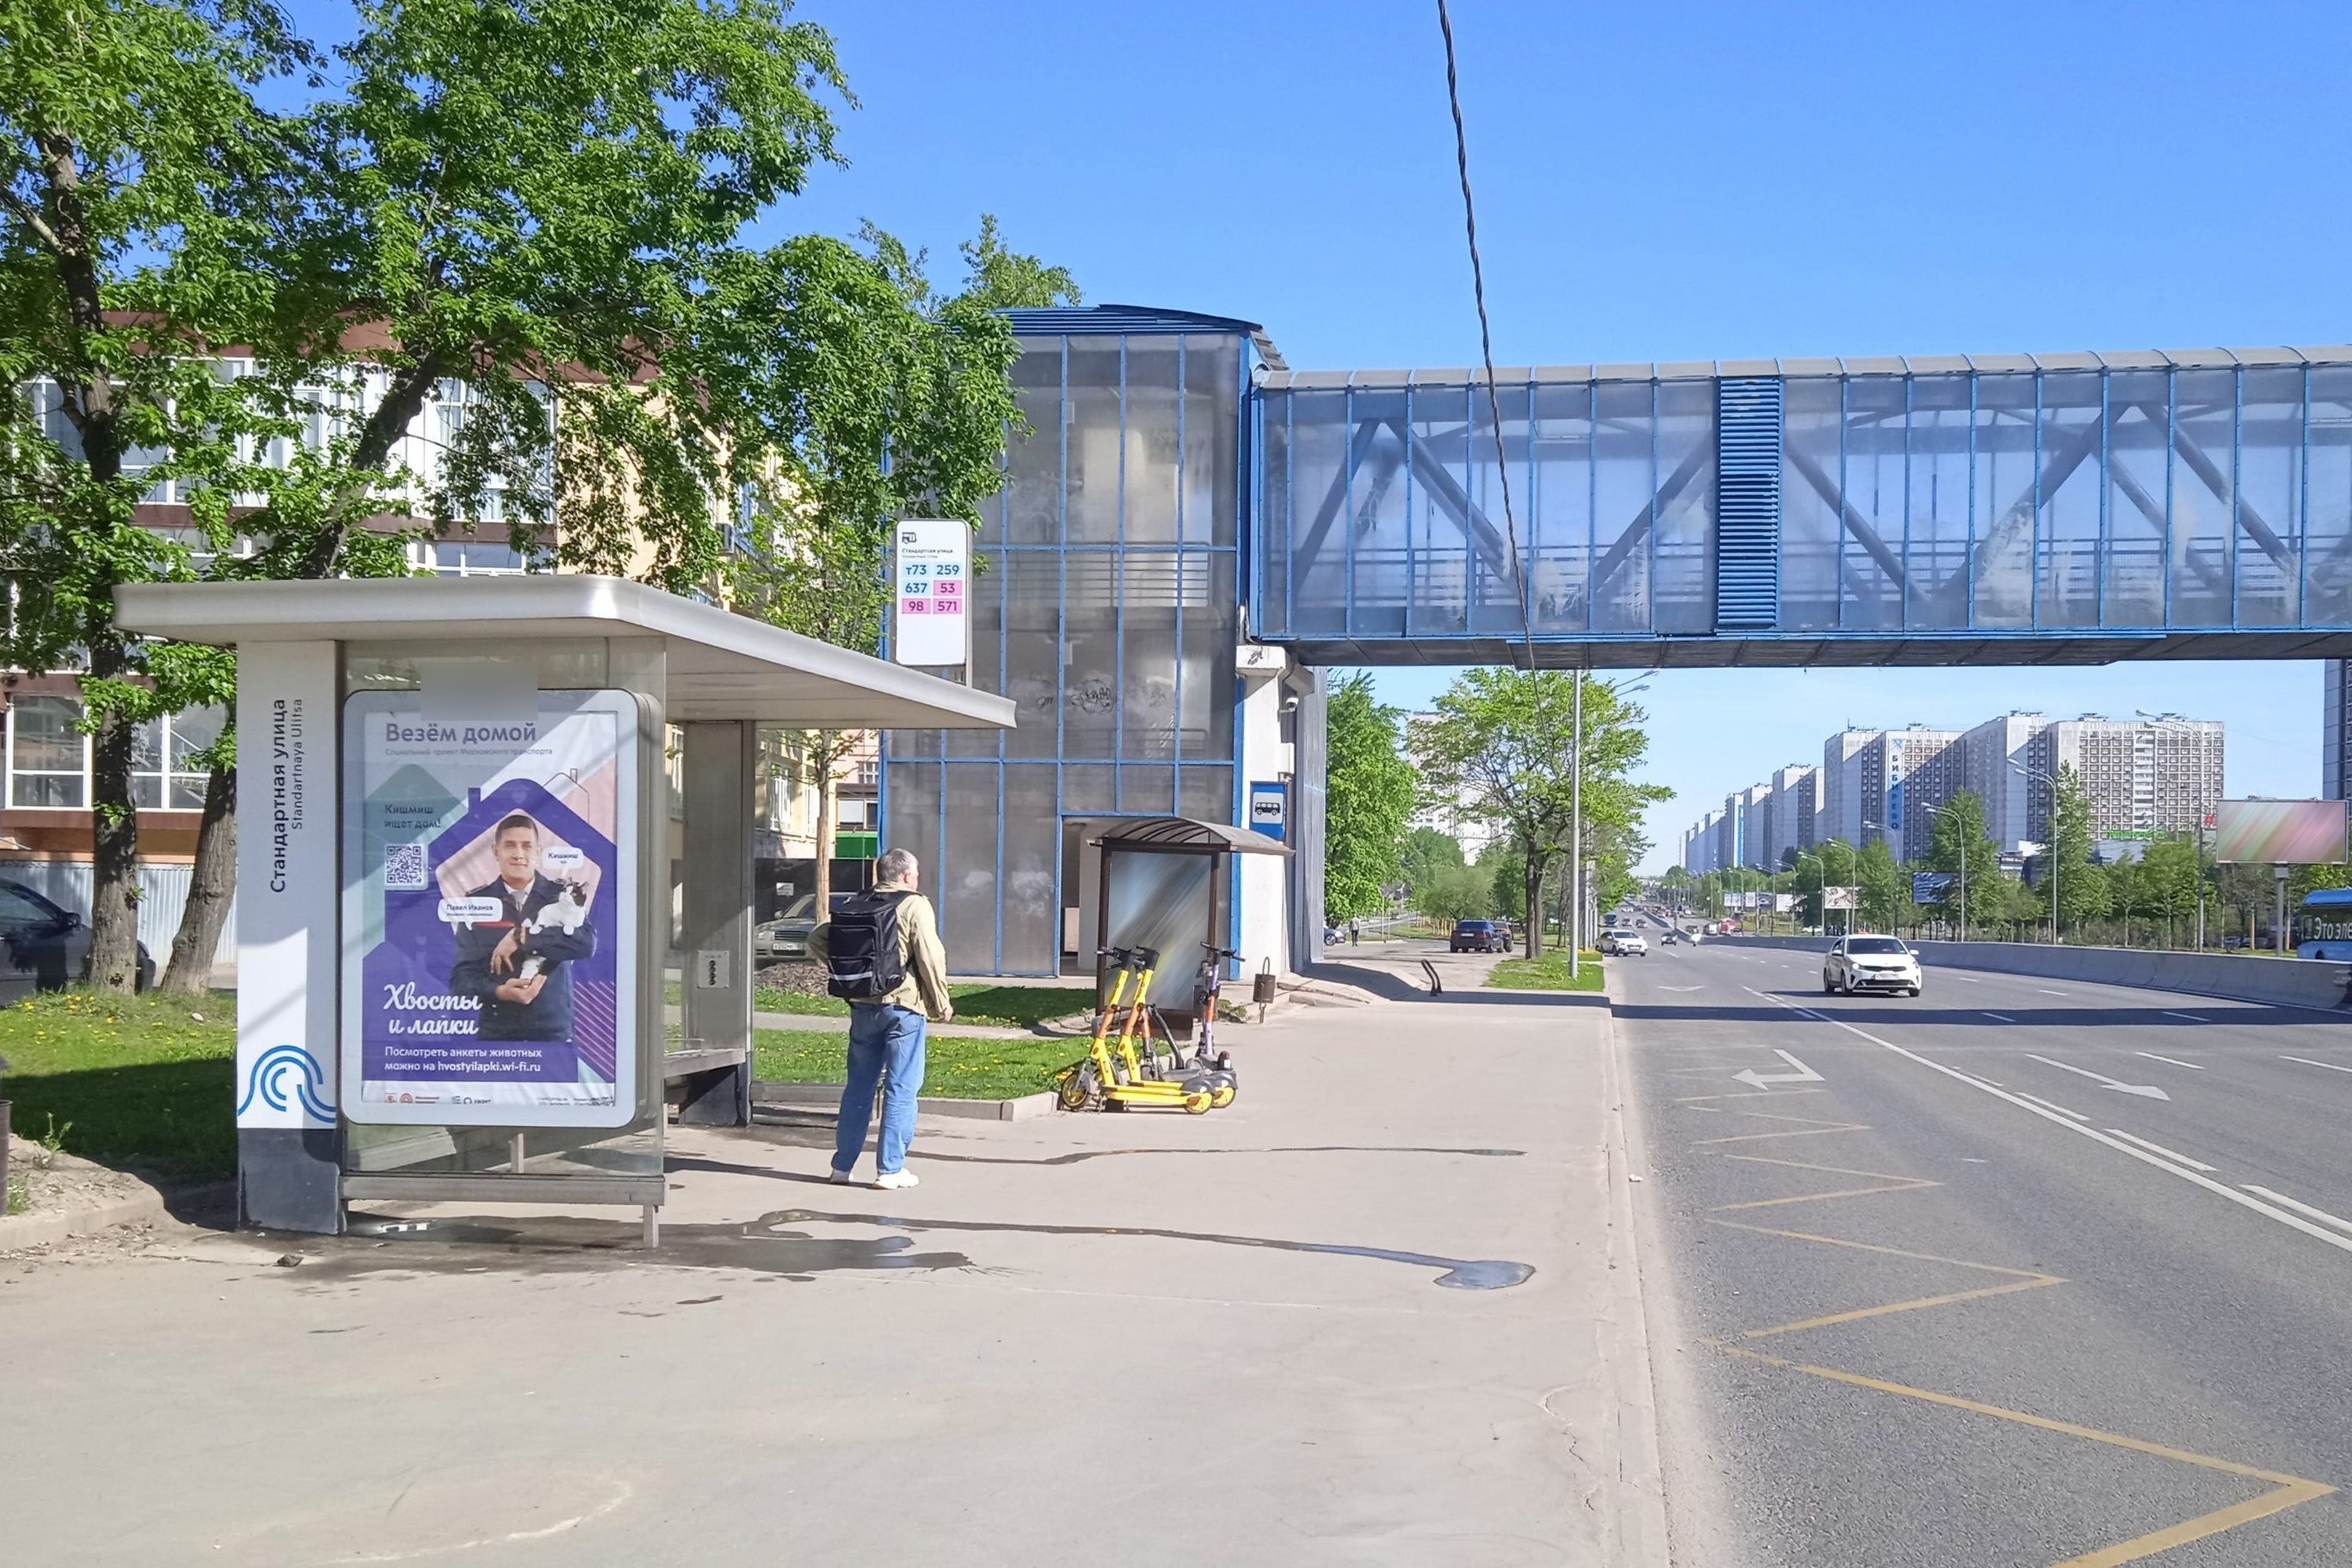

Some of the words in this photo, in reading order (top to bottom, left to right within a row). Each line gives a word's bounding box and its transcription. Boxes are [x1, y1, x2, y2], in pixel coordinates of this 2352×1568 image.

[936, 565, 959, 575] 259
[905, 582, 927, 593] 637
[940, 582, 955, 593] 53
[908, 601, 924, 612] 98
[938, 601, 957, 612] 571
[291, 698, 303, 738] Ulitsa
[274, 699, 289, 759] улица
[386, 723, 457, 742] Везём
[462, 722, 536, 744] домой
[292, 741, 305, 830] Standartnaya
[385, 803, 434, 814] Кишмиш
[270, 764, 289, 893] Стандартная
[385, 820, 413, 829] ищет
[415, 818, 440, 829] дом!
[2313, 917, 2333, 939] Это
[383, 981, 483, 1011] Хвосты
[389, 1018, 405, 1035] и
[407, 1015, 479, 1035] лапки
[385, 1046, 448, 1058] Посмотреть
[450, 1048, 487, 1057] анкеты
[489, 1048, 542, 1058] животных
[385, 1062, 421, 1071] можно
[437, 1061, 541, 1073] hvostyilapki.wi-fi.ru
